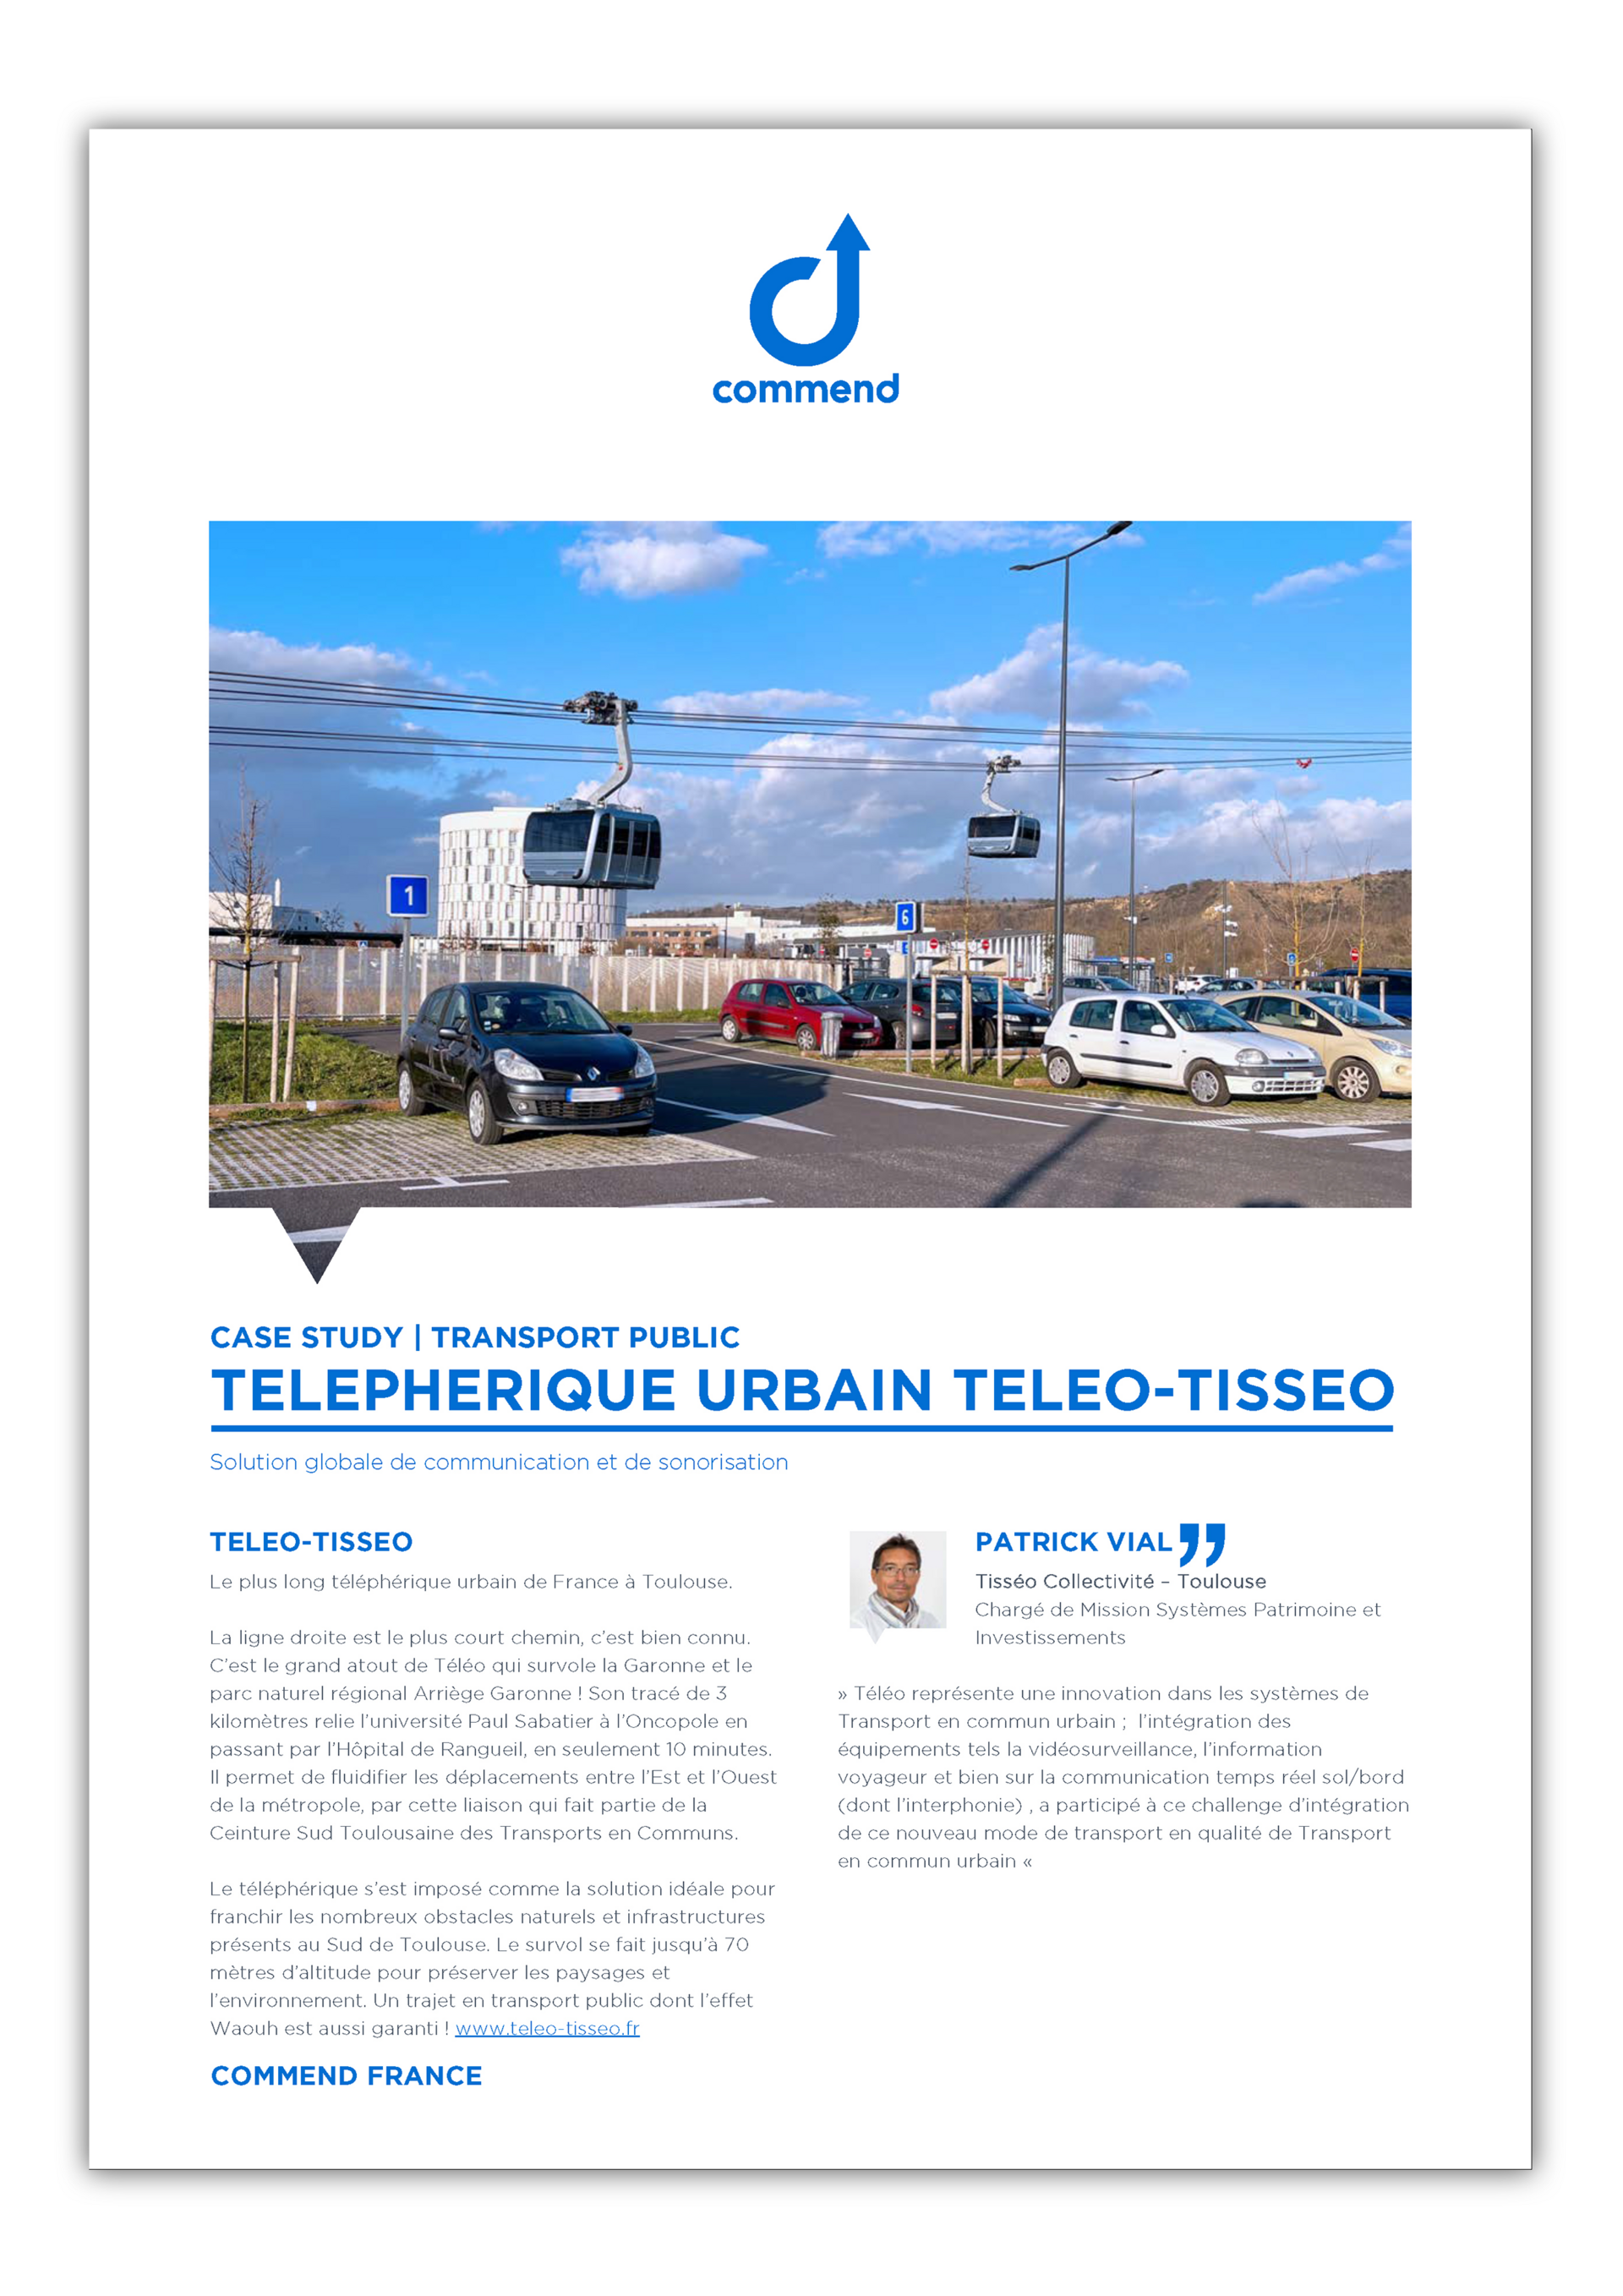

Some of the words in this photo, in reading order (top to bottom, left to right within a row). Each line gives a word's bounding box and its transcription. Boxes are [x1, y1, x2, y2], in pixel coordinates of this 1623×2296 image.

[712, 372, 900, 404] commend
[404, 885, 413, 906] 1
[901, 909, 910, 926] 6
[210, 1326, 292, 1349] CASE
[301, 1326, 404, 1349] STUDY
[430, 1326, 620, 1349] TRANSPORT
[629, 1326, 740, 1349] PUBLIC
[210, 1368, 675, 1413] TELEPHERIQUE
[698, 1368, 931, 1412] URBAIN
[953, 1368, 1395, 1412] TELEO-TISSEO
[210, 1452, 298, 1471] Solution
[304, 1452, 384, 1474] globale
[390, 1452, 417, 1471] de
[424, 1452, 589, 1471] communication
[596, 1453, 618, 1471] et
[624, 1452, 652, 1471] de
[658, 1452, 789, 1471] sonorisation
[209, 1530, 413, 1553] TELEO-TISSEO
[976, 1530, 1099, 1553] PATRICK
[1106, 1531, 1173, 1552] VIAL
[210, 1574, 232, 1589] Le
[239, 1573, 278, 1592] plus
[284, 1573, 325, 1593] long
[331, 1573, 451, 1593] téléphérique
[457, 1573, 516, 1589] urbain
[523, 1573, 548, 1589] de
[553, 1574, 619, 1589] France
[625, 1573, 636, 1589] à
[642, 1573, 732, 1589] Toulouse.
[975, 1573, 1037, 1589] Tisséo
[1043, 1572, 1155, 1589] Collectivité
[1177, 1572, 1267, 1589] Toulouse
[975, 1601, 1045, 1621] Chargé
[1050, 1601, 1074, 1617] de
[1080, 1602, 1150, 1617] Mission
[1156, 1601, 1247, 1621] Systèmes
[1254, 1601, 1357, 1617] Patrimoine
[1362, 1602, 1382, 1617] et
[210, 1630, 232, 1645] La
[239, 1629, 285, 1648] ligne
[290, 1629, 347, 1645] droite
[352, 1630, 381, 1645] est
[387, 1629, 404, 1645] le
[410, 1629, 448, 1648] plus
[454, 1630, 505, 1645] court
[511, 1629, 584, 1648] chemin,
[591, 1630, 635, 1645] c’est
[641, 1629, 681, 1645] bien
[687, 1633, 751, 1645] connu.
[976, 1630, 1126, 1645] Investissements
[210, 1689, 253, 1704] parc
[259, 1685, 325, 1701] naturel
[331, 1685, 407, 1704] régional
[413, 1686, 484, 1704] Arriège
[489, 1685, 572, 1701] Garonne
[588, 1686, 625, 1701] Son
[631, 1686, 680, 1701] tracé
[686, 1685, 710, 1701] de
[716, 1685, 727, 1701] 3
[854, 1685, 905, 1701] Téléo
[912, 1686, 1014, 1704] représente
[1021, 1689, 1056, 1701] une
[1062, 1686, 1161, 1701] innovation
[1167, 1685, 1212, 1701] dans
[1219, 1685, 1243, 1701] les
[1249, 1686, 1339, 1704] systèmes
[1345, 1685, 1369, 1701] de
[838, 1713, 932, 1732] Transport
[937, 1717, 959, 1729] en
[966, 1717, 1050, 1729] commun
[1057, 1713, 1116, 1729] urbain
[1139, 1713, 1252, 1732] l’intégration
[1258, 1713, 1292, 1729] des
[838, 1741, 961, 1760] équipements
[968, 1741, 1001, 1757] tels
[1008, 1741, 1022, 1757] la
[1028, 1741, 1197, 1759] vidéosurveillance,
[1204, 1741, 1322, 1757] l’information
[210, 1768, 219, 1785] Il
[226, 1769, 295, 1788] permet
[301, 1768, 325, 1785] de
[331, 1768, 407, 1785] fluidifier
[414, 1768, 439, 1785] les
[445, 1768, 579, 1788] déplacements
[585, 1769, 636, 1785] entre
[642, 1768, 681, 1785] l’Est
[686, 1769, 706, 1785] et
[712, 1768, 778, 1785] l’Ouest
[837, 1773, 927, 1788] voyageur
[933, 1769, 953, 1785] et
[959, 1768, 999, 1785] bien
[1005, 1773, 1035, 1785] sur
[1041, 1768, 1055, 1785] la
[1062, 1769, 1210, 1785] communication
[1216, 1769, 1275, 1788] temps
[1282, 1768, 1316, 1785] réel
[1322, 1767, 1404, 1787] sol/bord
[210, 1825, 291, 1841] Ceinture
[297, 1824, 333, 1841] Sud
[340, 1824, 455, 1841] Toulousaine
[460, 1824, 494, 1841] des
[500, 1825, 602, 1844] Transports
[608, 1829, 631, 1841] en
[637, 1825, 738, 1841] Communs.
[838, 1856, 861, 1868] en
[866, 1856, 950, 1868] commun
[957, 1852, 1016, 1868] urbain
[210, 1881, 232, 1896] Le
[239, 1880, 358, 1900] téléphérique
[364, 1881, 407, 1896] s’est
[413, 1881, 483, 1900] imposé
[488, 1884, 560, 1896] comme
[566, 1880, 581, 1896] la
[587, 1880, 663, 1896] solution
[669, 1880, 725, 1896] idéale
[731, 1884, 776, 1900] pour
[210, 1908, 283, 1925] franchir
[289, 1908, 314, 1925] les
[320, 1908, 418, 1925] nombreux
[424, 1908, 514, 1925] obstacles
[521, 1908, 596, 1925] naturels
[602, 1910, 621, 1925] et
[627, 1908, 766, 1925] infrastructures
[210, 1965, 276, 1981] mètres
[281, 1964, 371, 1981] d’altitude
[378, 1968, 422, 1983] pour
[429, 1965, 519, 1983] préserver
[525, 1964, 549, 1981] les
[556, 1968, 645, 1983] paysages
[652, 1965, 670, 1981] et
[210, 1992, 367, 2009] l’environnement.
[374, 1993, 399, 2009] Un
[406, 1993, 456, 2011] trajet
[462, 1996, 484, 2009] en
[490, 1993, 580, 2011] transport
[586, 1992, 644, 2011] public
[649, 1992, 695, 2009] dont
[701, 1992, 754, 2009] l’effet
[210, 2020, 278, 2036] Waouh
[284, 2021, 313, 2036] est
[319, 2020, 365, 2036] aussi
[371, 2020, 438, 2039] garanti
[454, 2020, 642, 2038] www.teleo-tisseo.fr
[210, 2064, 358, 2087] COMMEND
[368, 2064, 483, 2087] FRANCE
